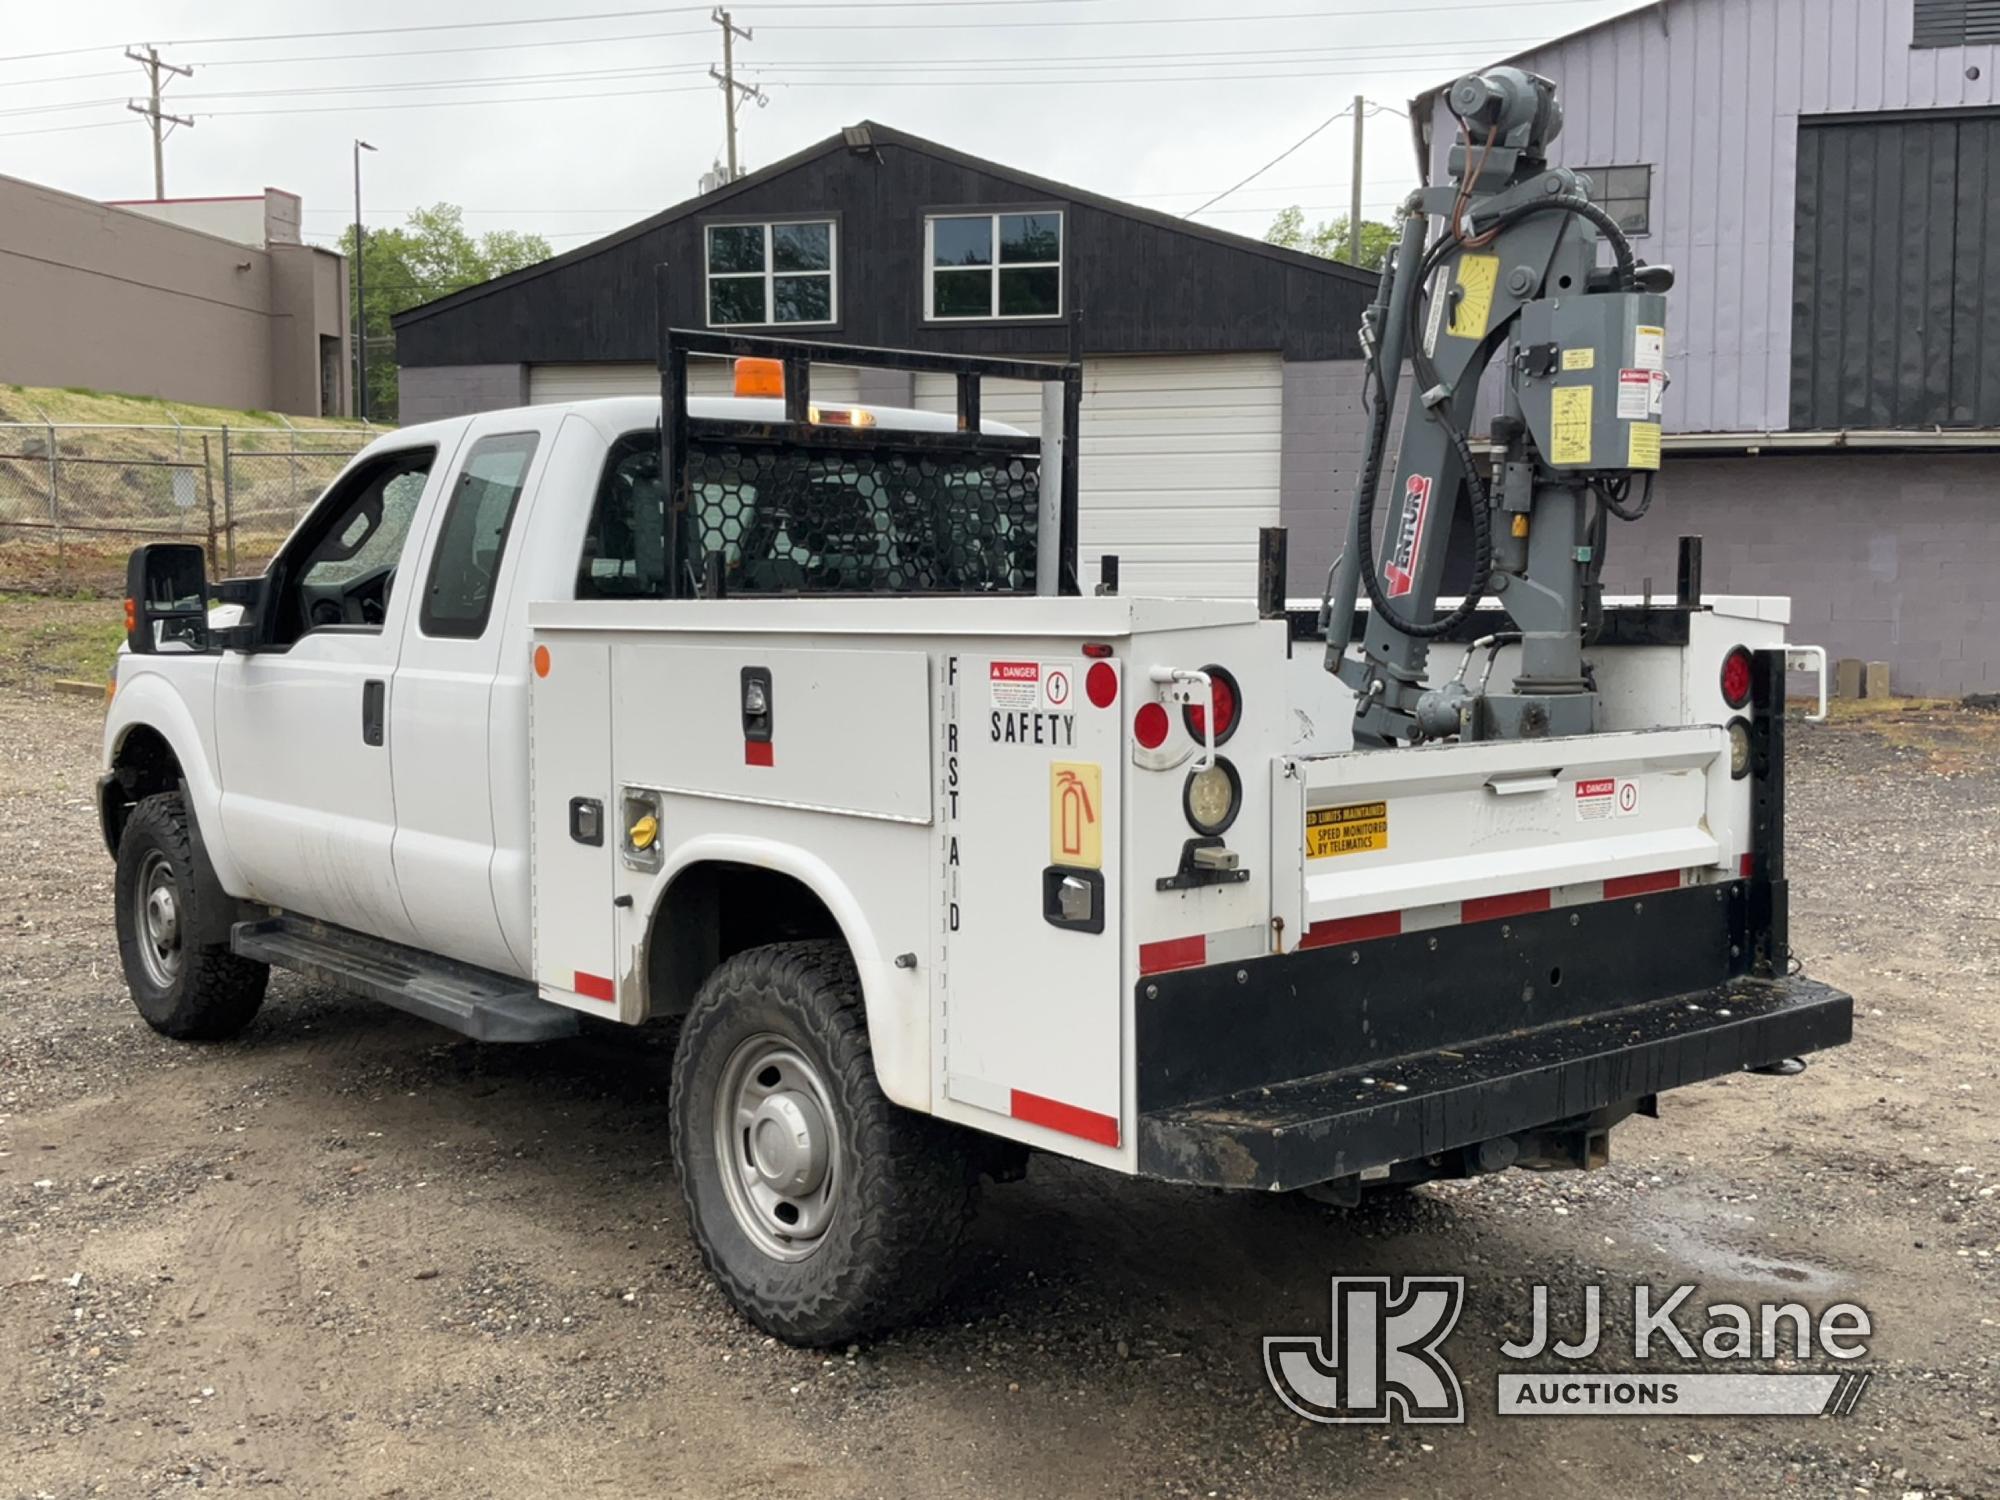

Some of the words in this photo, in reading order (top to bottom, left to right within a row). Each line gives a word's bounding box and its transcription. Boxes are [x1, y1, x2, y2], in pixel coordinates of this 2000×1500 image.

[1003, 667, 1037, 677] DANGER
[991, 711, 1074, 745] SAFETY
[1586, 782, 1613, 794] DANGER
[1318, 827, 1341, 841] SPEED
[1343, 821, 1387, 837] MONITORED
[1318, 842, 1328, 854] BY
[1331, 836, 1373, 852] TELEMATICS
